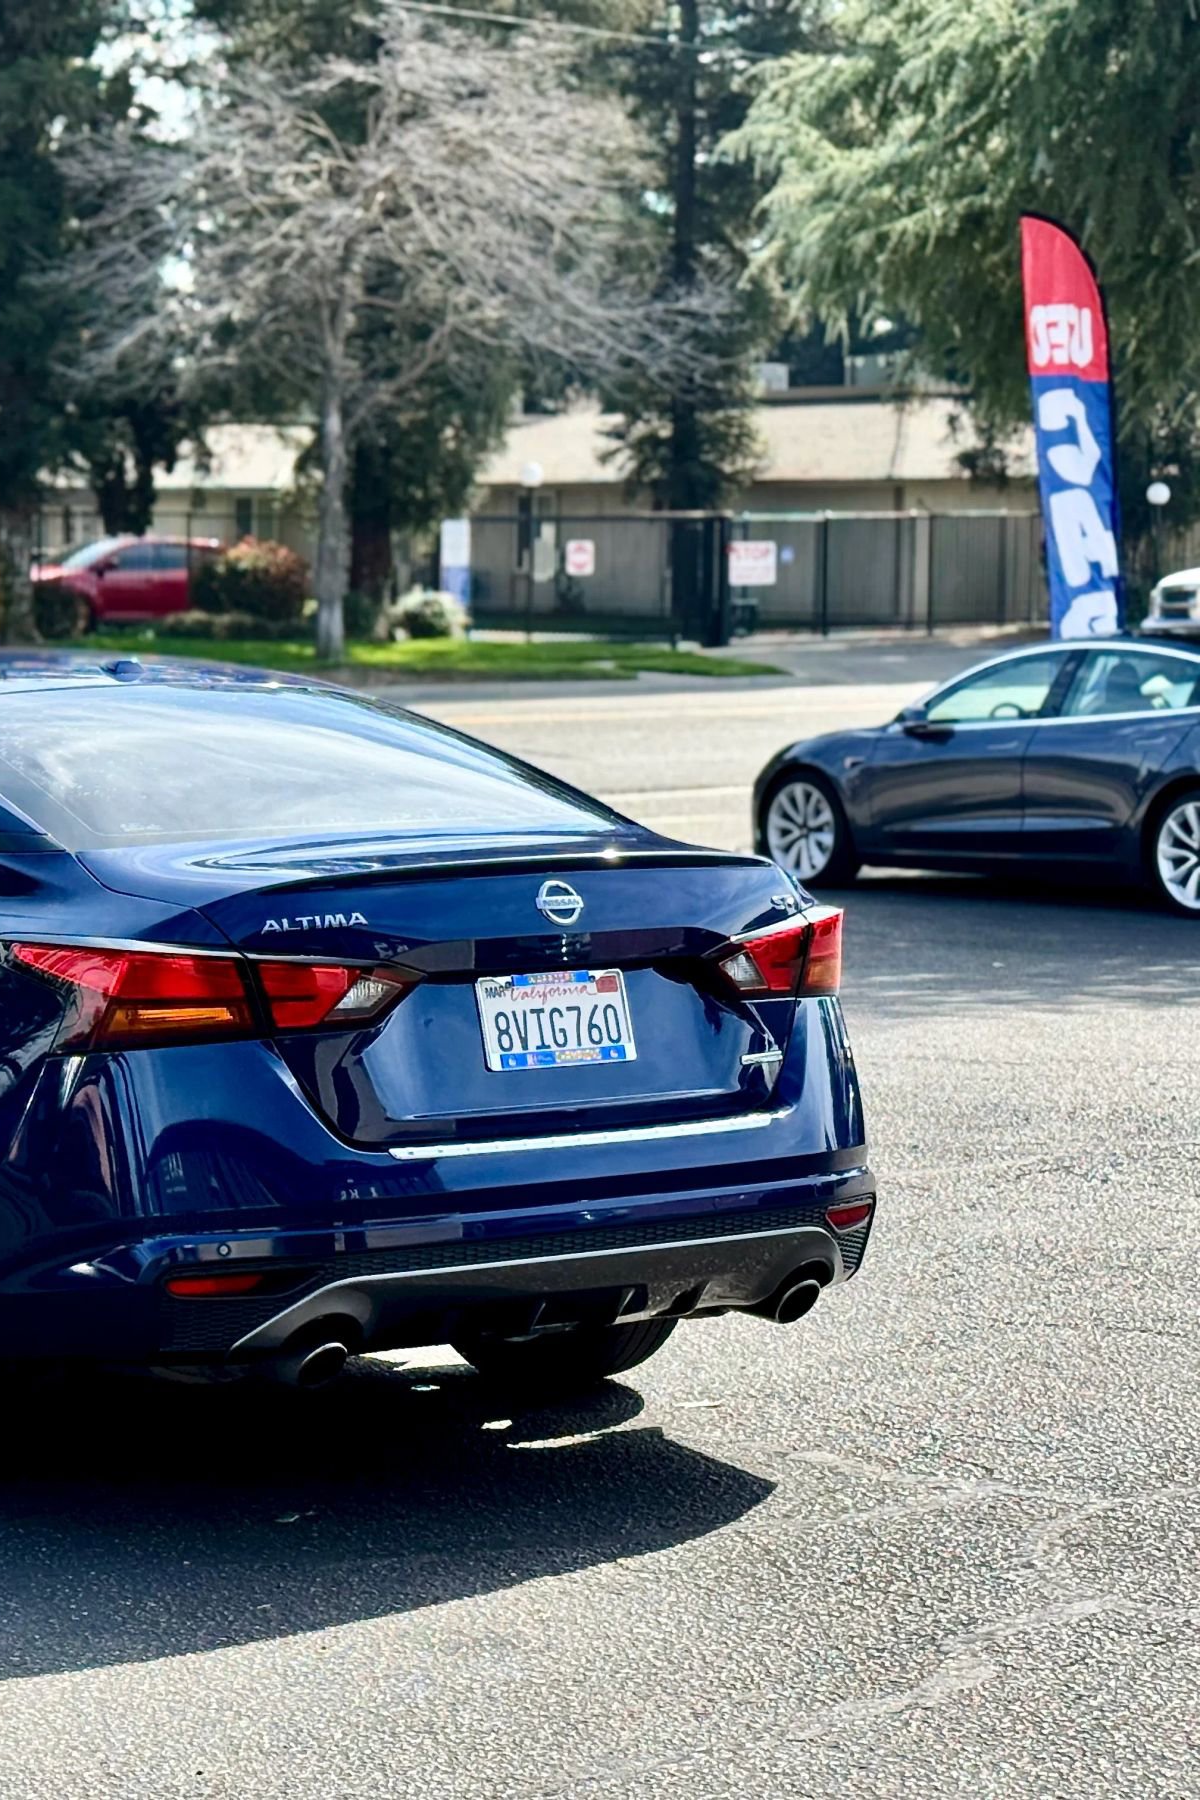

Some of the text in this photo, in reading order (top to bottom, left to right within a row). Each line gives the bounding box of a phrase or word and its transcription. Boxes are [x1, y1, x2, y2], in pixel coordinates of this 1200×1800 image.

[542, 898, 580, 907] NISSAN
[261, 911, 369, 935] ALTIMA
[510, 984, 598, 1005] California
[494, 1003, 622, 1052] 8VIG760
